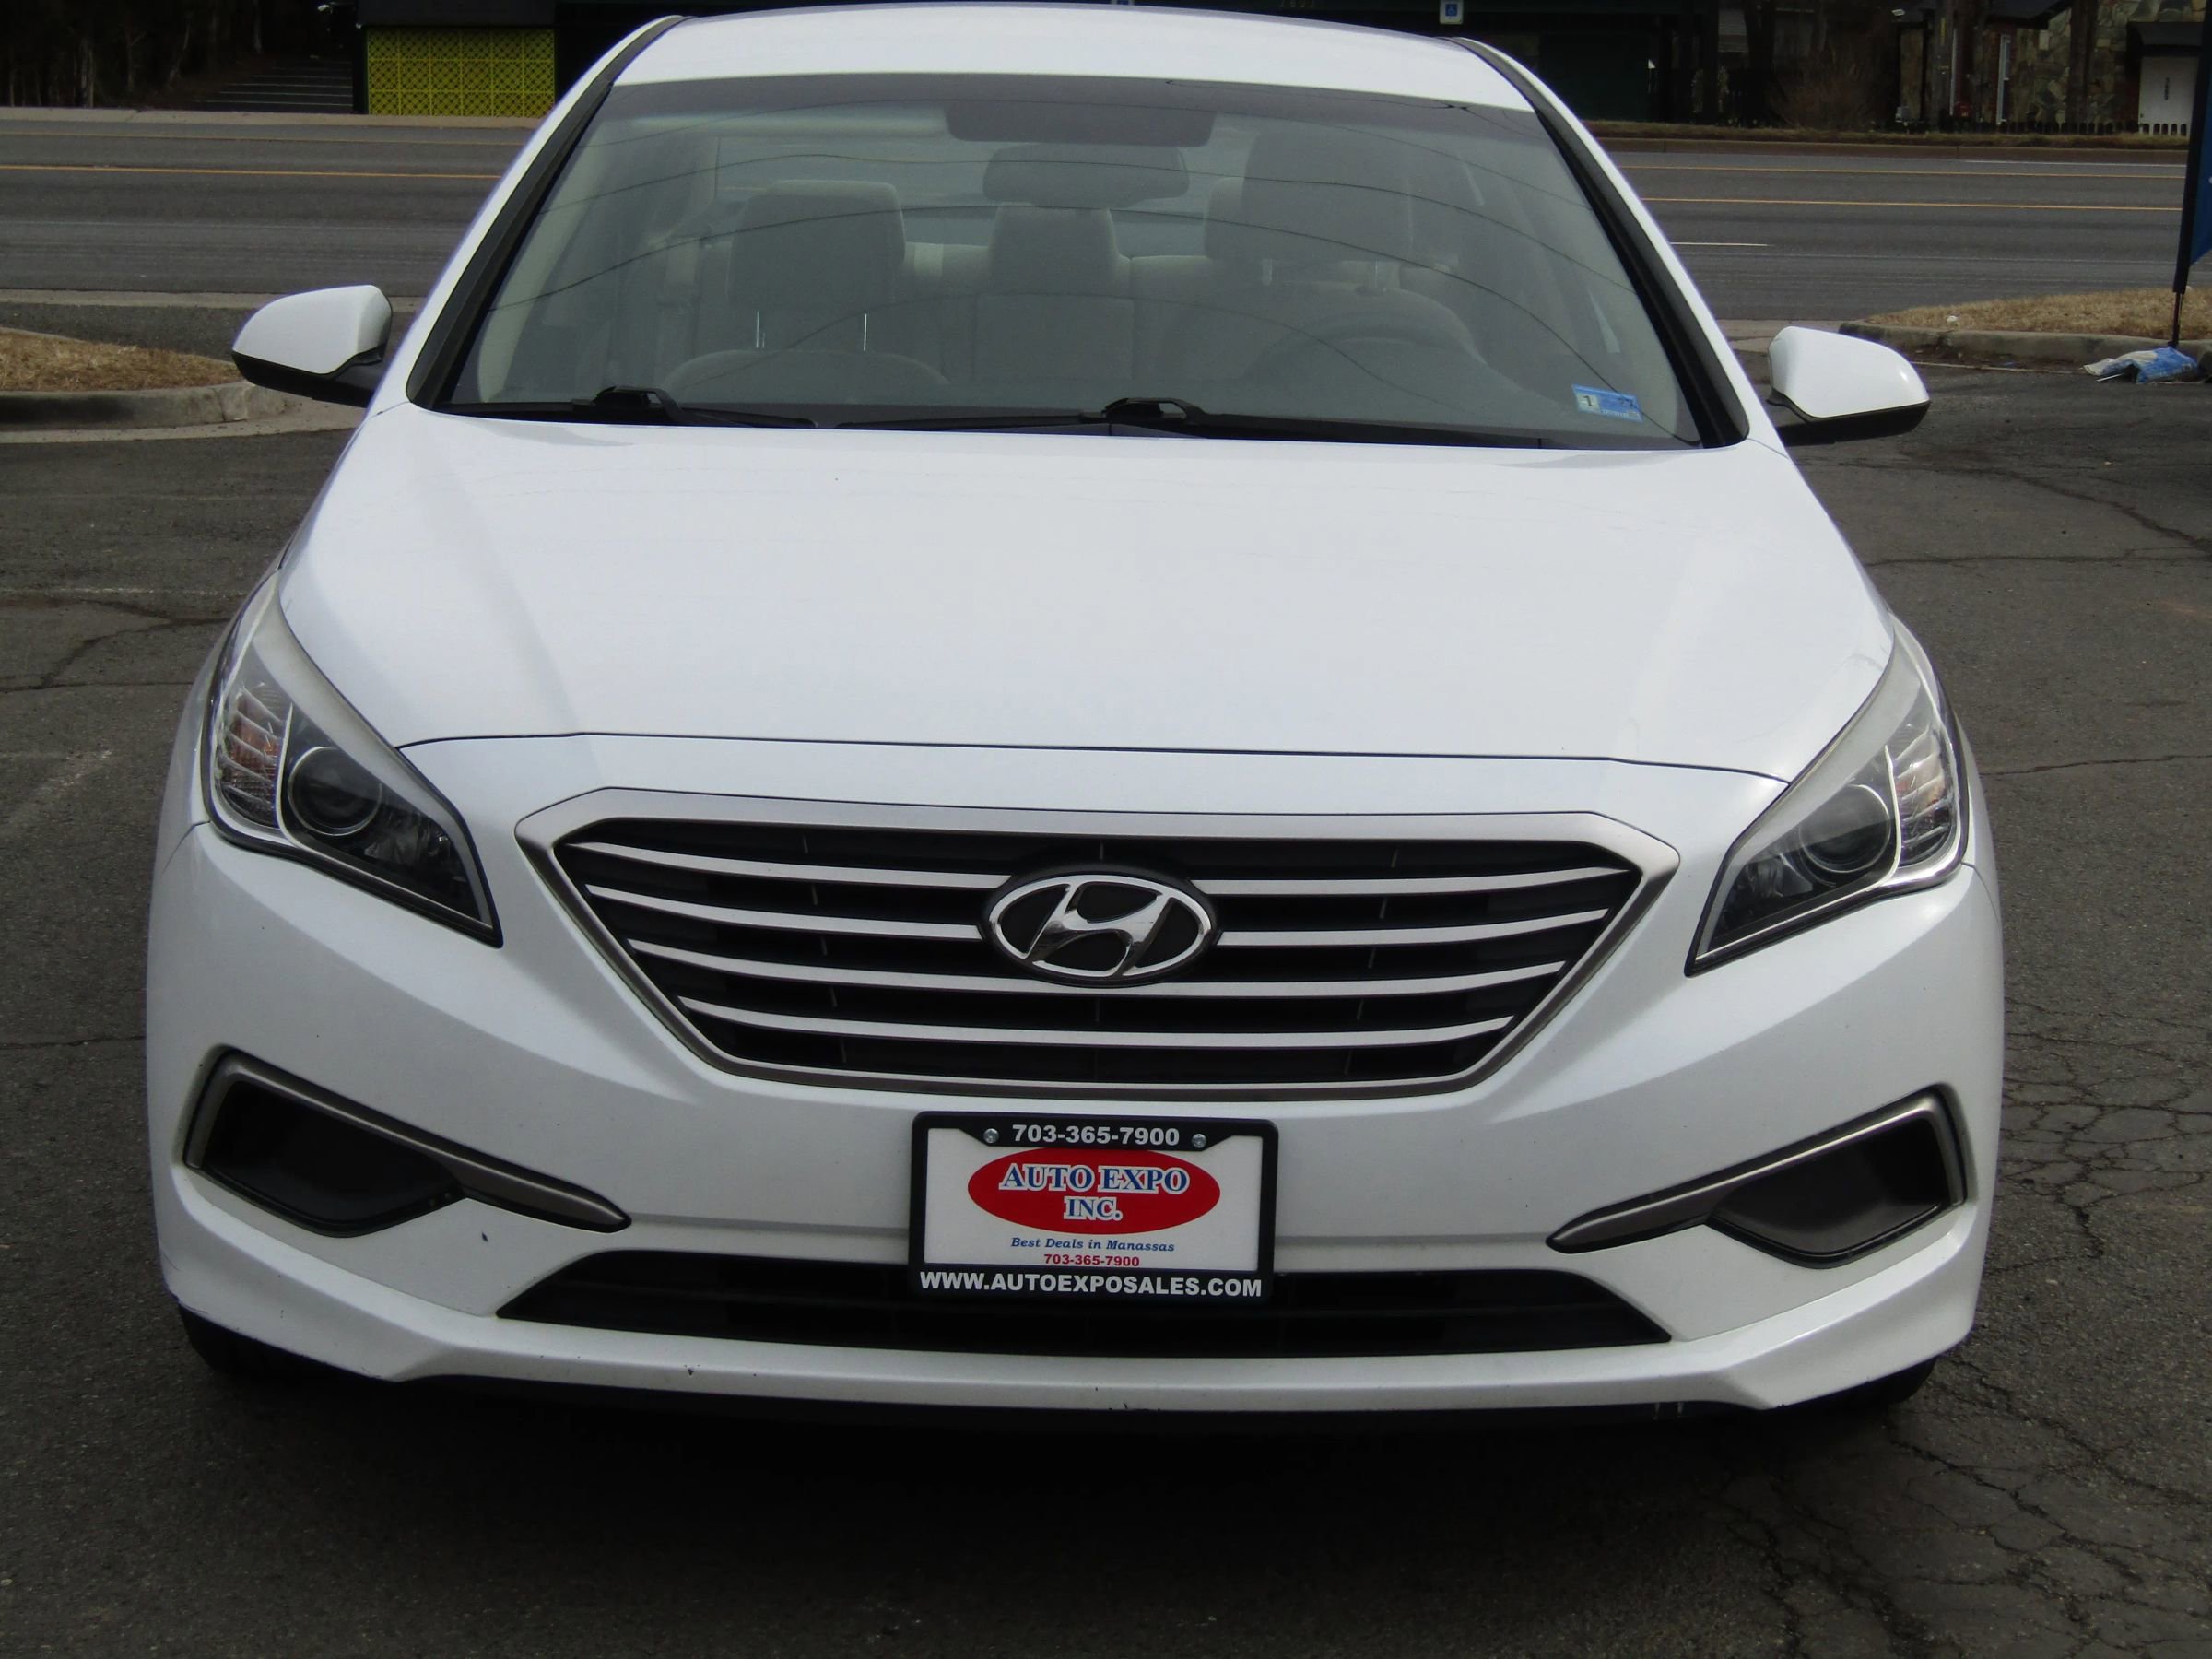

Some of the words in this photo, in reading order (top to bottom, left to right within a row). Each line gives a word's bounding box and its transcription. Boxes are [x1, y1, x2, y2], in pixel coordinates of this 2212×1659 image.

[1012, 1124, 1180, 1147] 703-365-7900
[1000, 1162, 1095, 1193] AUTO
[1097, 1165, 1190, 1194] EXPO
[1064, 1196, 1123, 1221] INC.
[1011, 1237, 1041, 1248] Best
[1045, 1238, 1084, 1249] Deals
[1088, 1239, 1101, 1250] in
[1106, 1240, 1175, 1252] Manassas
[1043, 1253, 1140, 1266] 703-365-7900
[920, 1271, 1262, 1297] WWW.AUTOEXPOSALES.COM
